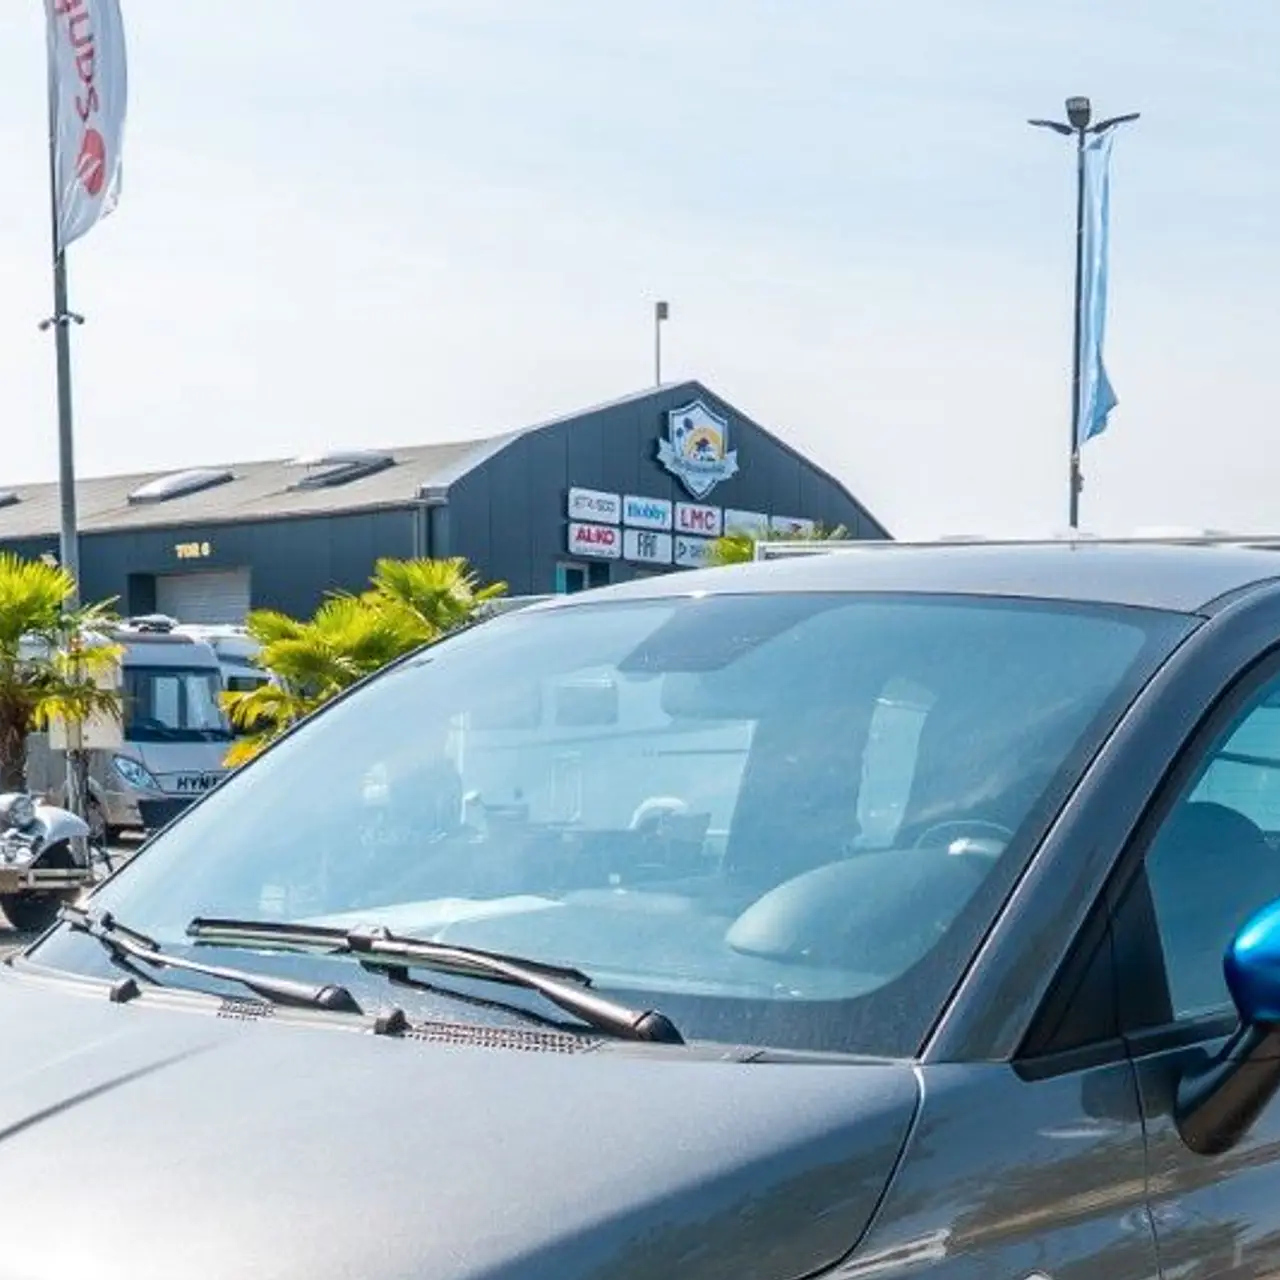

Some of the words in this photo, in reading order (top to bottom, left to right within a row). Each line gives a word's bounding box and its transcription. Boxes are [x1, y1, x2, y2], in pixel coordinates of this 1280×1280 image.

[627, 502, 667, 525] Hobby
[680, 508, 716, 530] LMC
[174, 542, 199, 558] TOR
